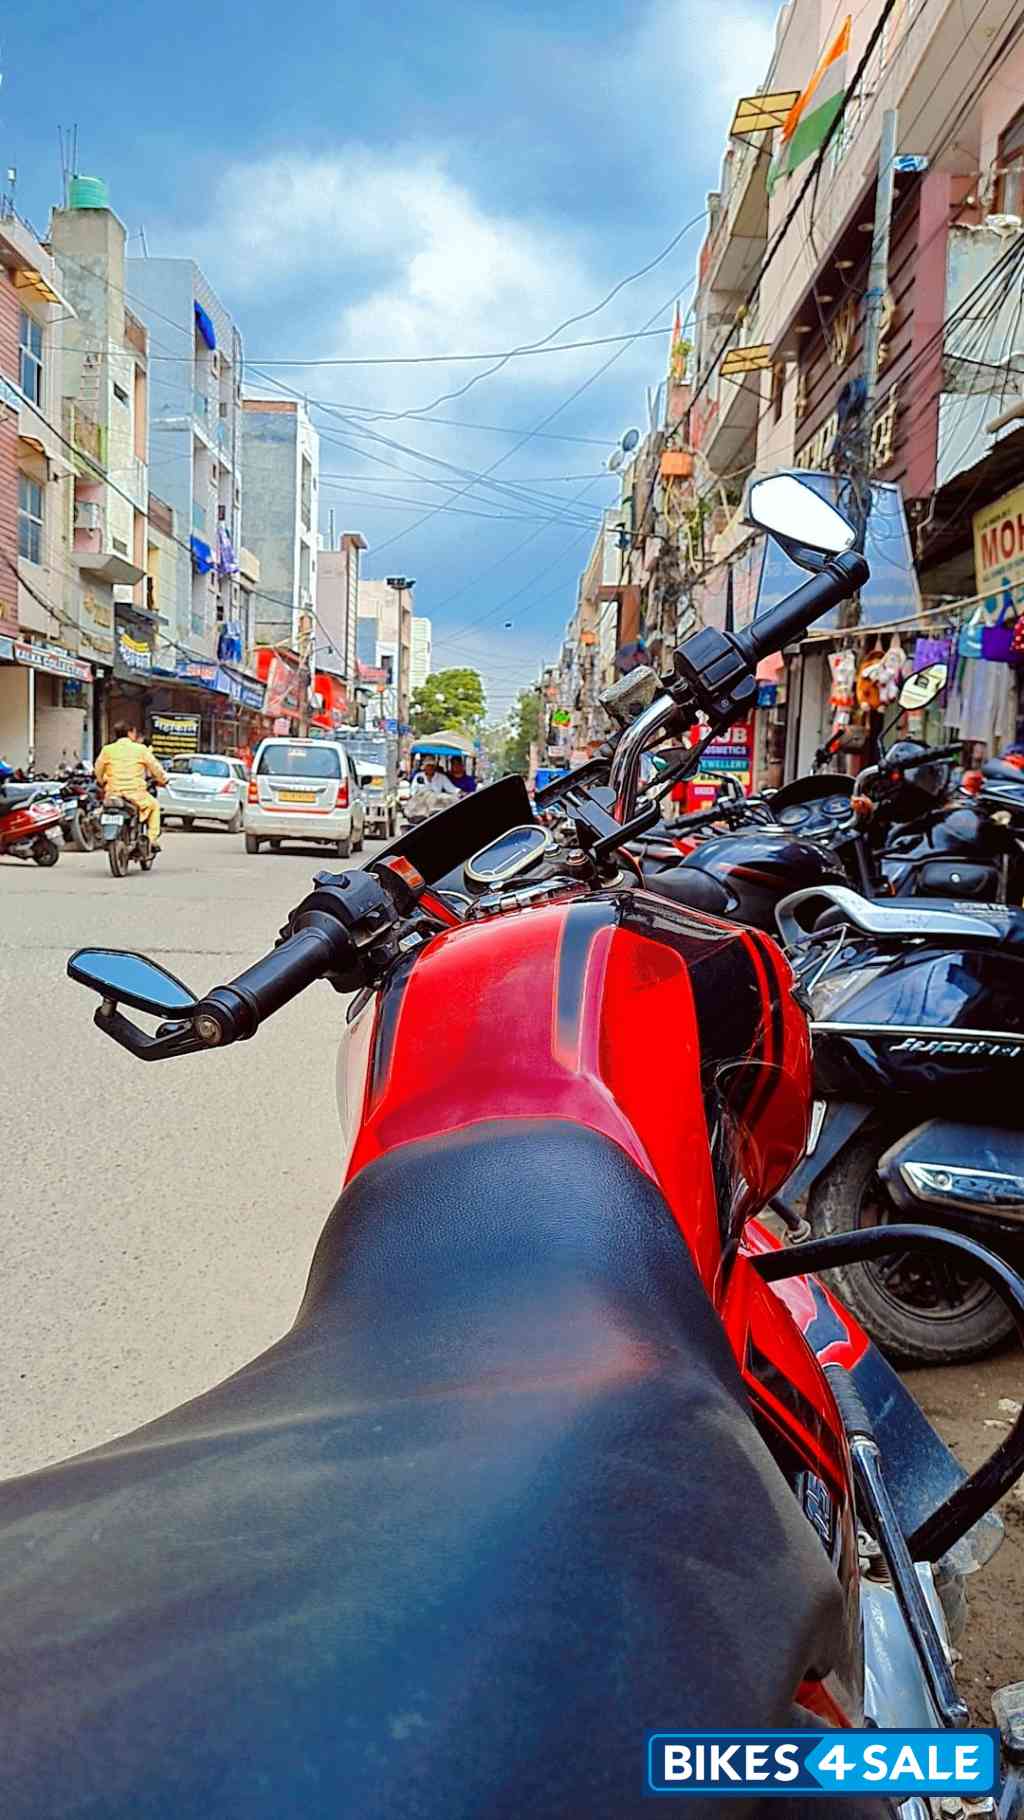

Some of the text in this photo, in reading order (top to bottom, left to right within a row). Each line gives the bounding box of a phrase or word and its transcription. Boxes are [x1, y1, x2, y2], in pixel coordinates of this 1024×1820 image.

[711, 727, 748, 744] UB
[702, 745, 747, 755] OSMETICS
[699, 760, 747, 769] EWELLERY
